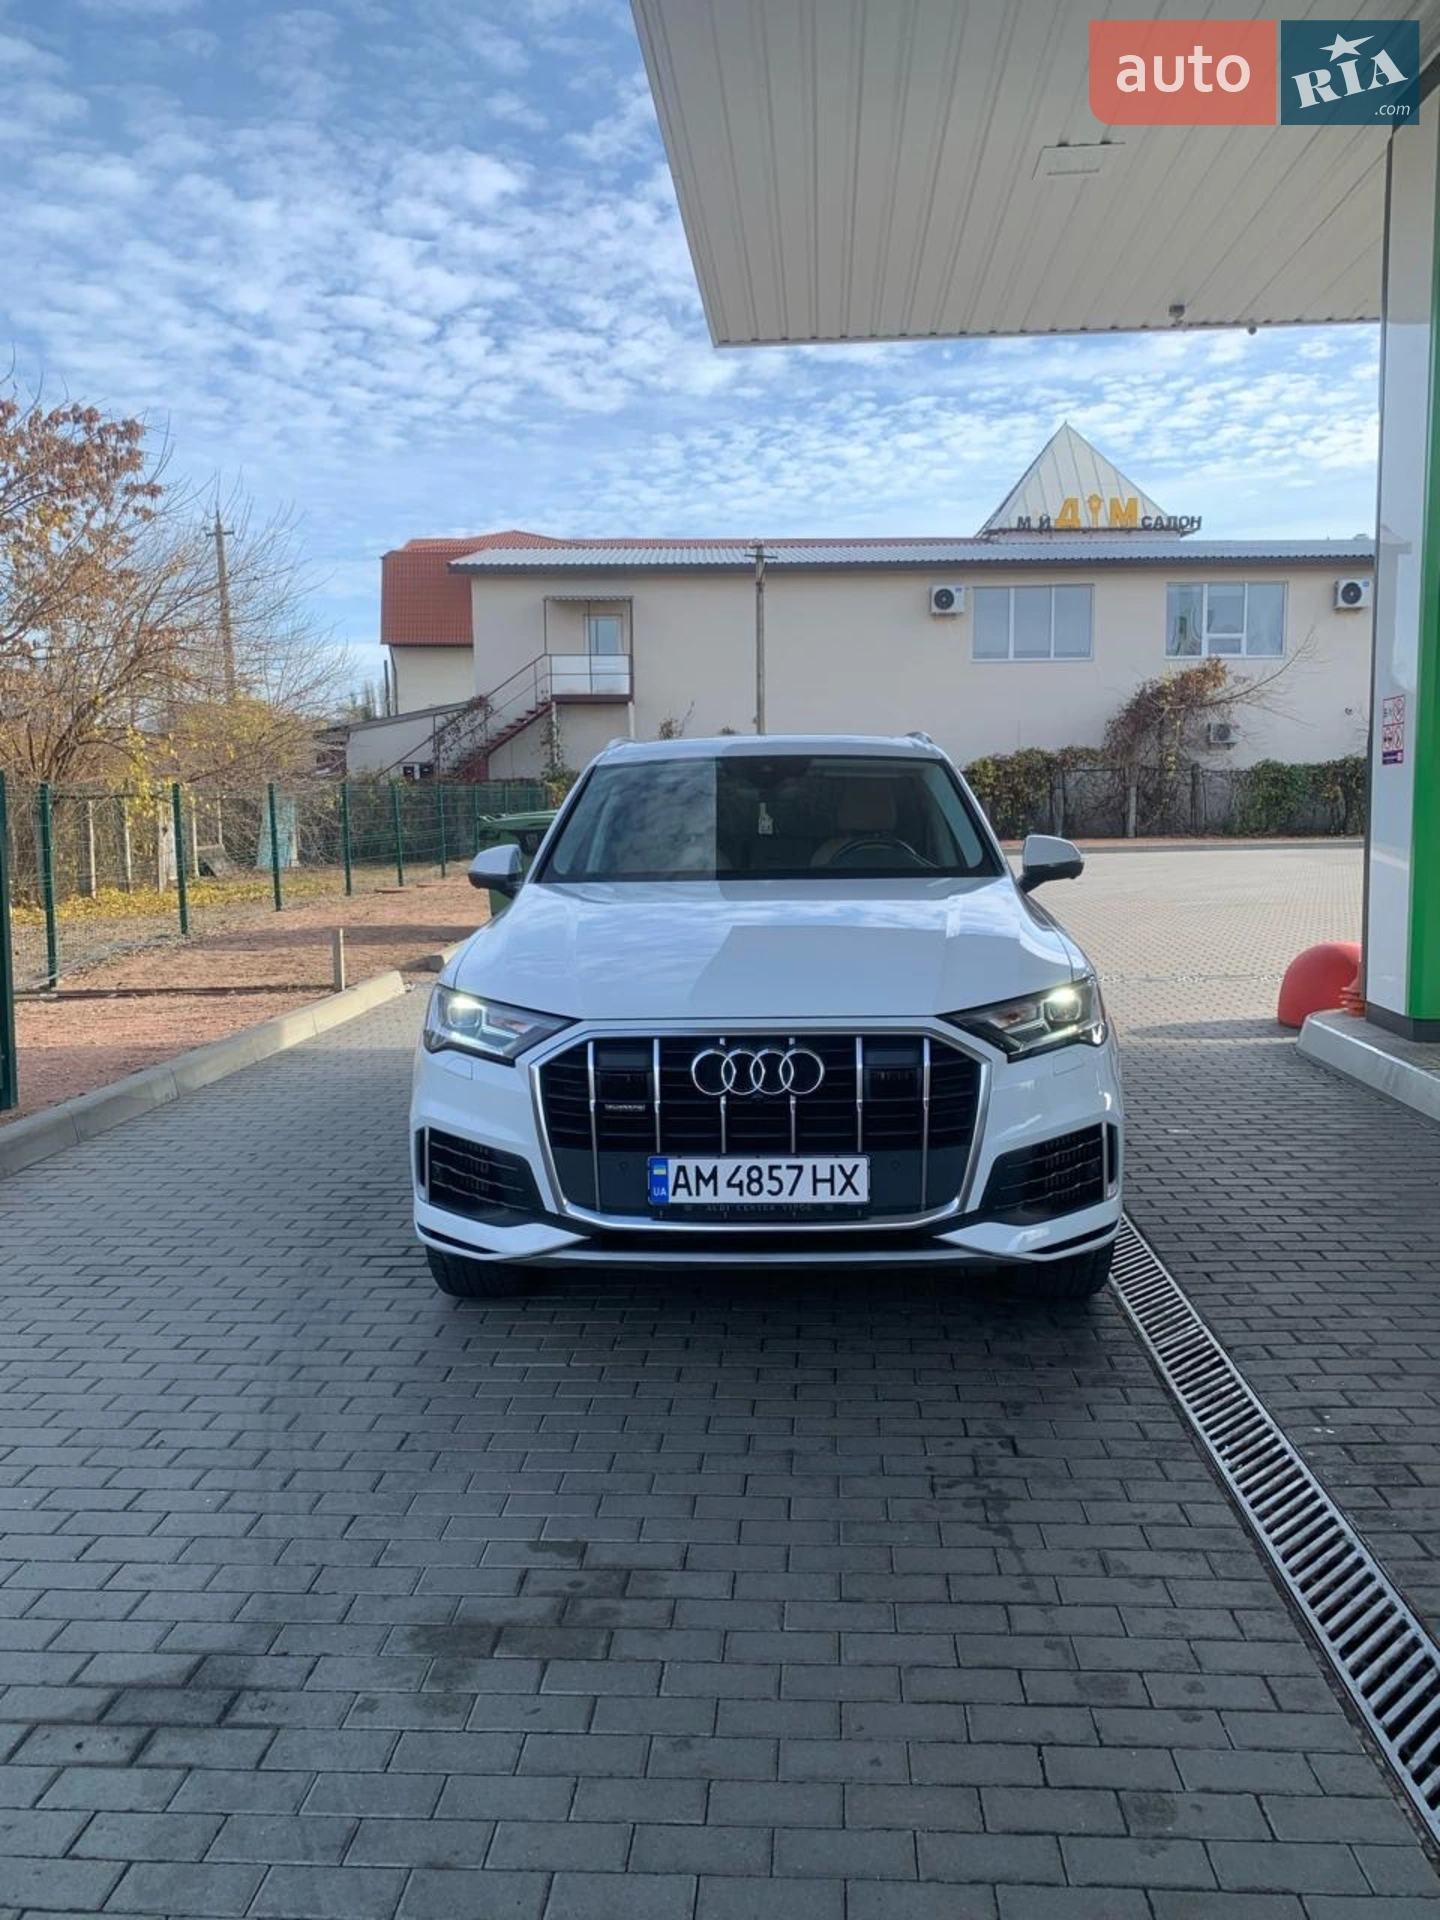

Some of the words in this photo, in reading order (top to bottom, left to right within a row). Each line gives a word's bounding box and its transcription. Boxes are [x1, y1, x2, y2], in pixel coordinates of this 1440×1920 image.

[1141, 515, 1202, 530] САЛОН
[671, 1165, 718, 1197] AM
[726, 1164, 804, 1197] 4857
[812, 1164, 860, 1197] HX
[653, 1187, 667, 1197] UA
